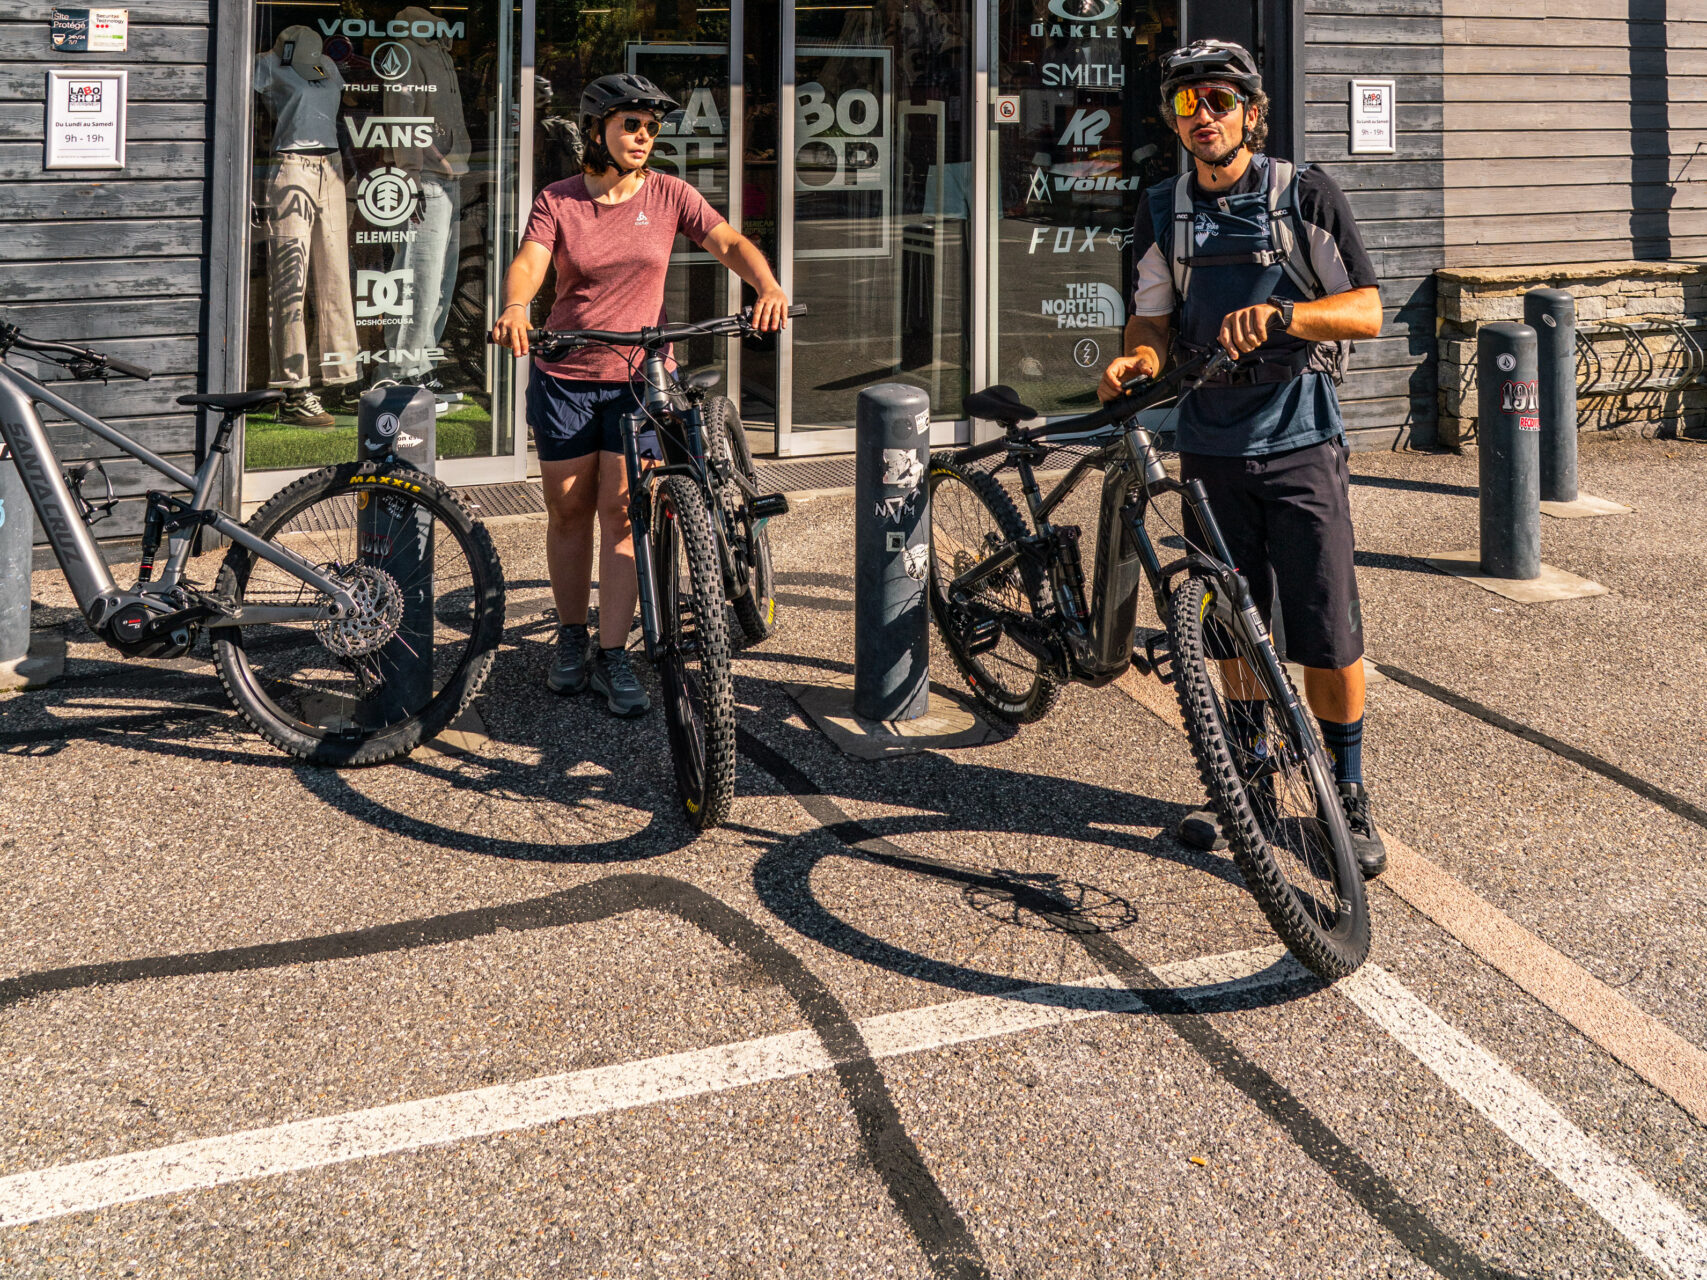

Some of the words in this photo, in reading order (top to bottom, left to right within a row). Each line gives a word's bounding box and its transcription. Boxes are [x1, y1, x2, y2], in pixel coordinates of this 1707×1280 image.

[54, 12, 70, 20] Site
[54, 21, 86, 30] Protégé
[318, 18, 465, 38] VOLCOM
[1031, 23, 1136, 38] OAKLEY
[1042, 63, 1125, 86] SMITH
[70, 86, 100, 95] LABO
[343, 84, 379, 92] TRUE
[383, 84, 402, 92] TO
[406, 84, 437, 93] THIS
[344, 117, 434, 148] VANS
[1057, 109, 1111, 146] K2
[65, 134, 77, 143] 9h
[87, 134, 104, 143] 19h
[1054, 174, 1140, 192] Völkl
[356, 231, 417, 244] ELEMENT
[1028, 226, 1101, 254] FOX
[1066, 283, 1097, 299] THE
[1042, 299, 1097, 315] NORTH
[1058, 314, 1097, 328] FACE
[349, 475, 421, 493] MAXXIS
[8, 423, 53, 500] SANTA
[43, 503, 84, 564] CRUZ
